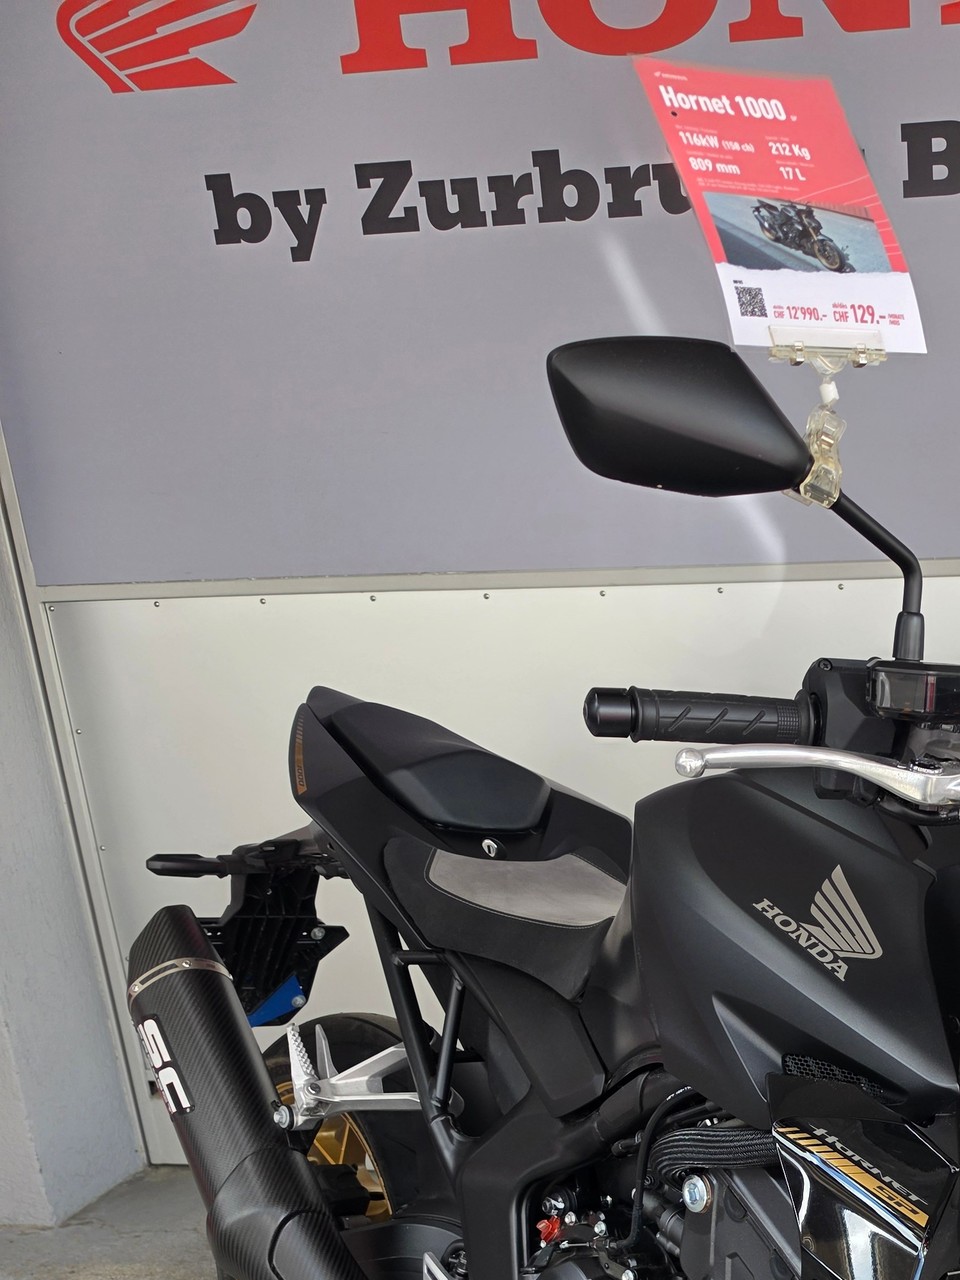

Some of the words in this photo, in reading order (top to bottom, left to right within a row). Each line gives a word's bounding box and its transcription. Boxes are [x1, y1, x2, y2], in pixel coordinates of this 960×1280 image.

[659, 84, 735, 115] Hornet
[734, 95, 787, 121] 1000
[678, 131, 720, 148] 116kW
[768, 141, 792, 156] 212
[791, 144, 811, 160] Kg
[688, 157, 713, 172] 809
[715, 163, 741, 175] mm
[779, 166, 793, 180] 17
[795, 168, 807, 181] L
[204, 173, 327, 263] by
[773, 310, 785, 318] CHF
[833, 310, 849, 322] CHF
[850, 303, 886, 325] 129.-
[752, 898, 848, 982] HONDA
[809, 1124, 928, 1205] HORNET
[872, 1185, 920, 1215] SP
